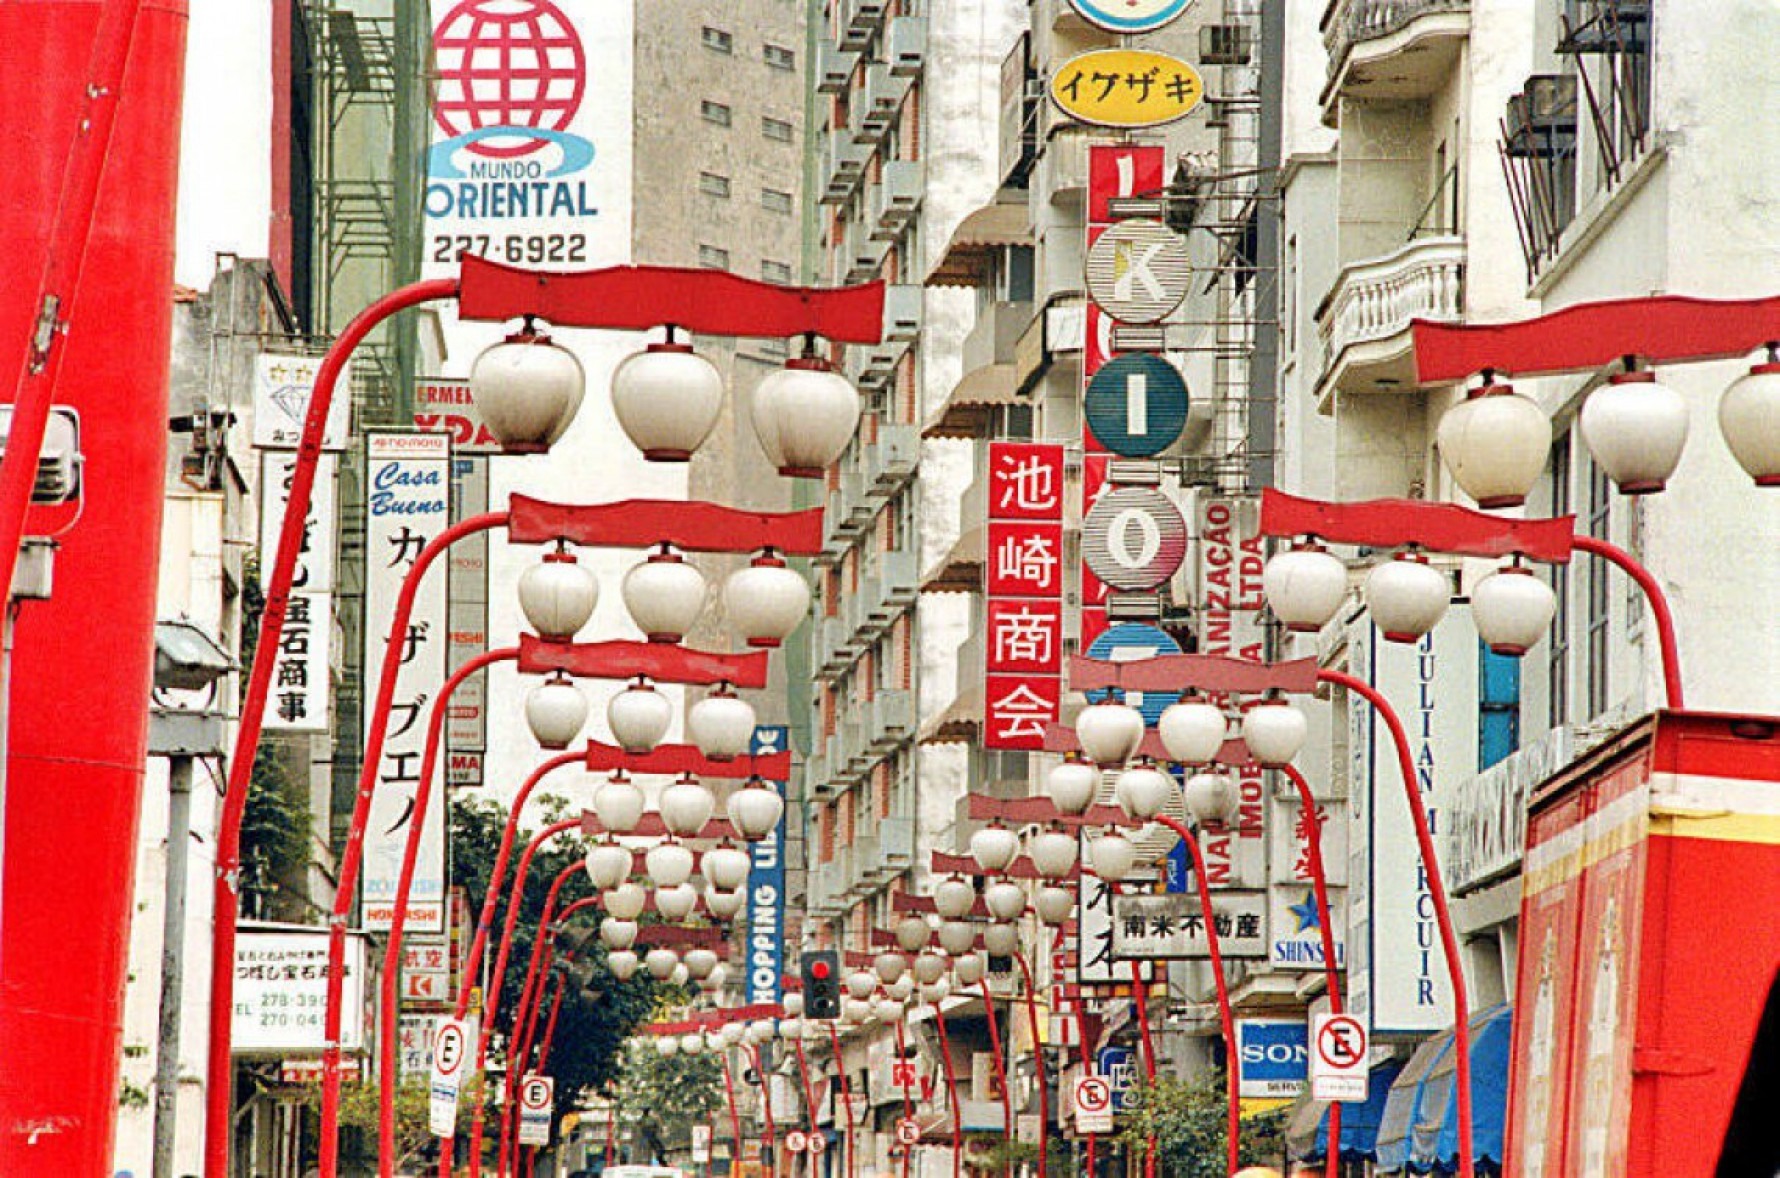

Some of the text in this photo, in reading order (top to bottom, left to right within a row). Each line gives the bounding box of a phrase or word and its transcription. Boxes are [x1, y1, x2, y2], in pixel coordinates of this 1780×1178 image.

[470, 161, 541, 178] MUNDO
[425, 181, 598, 218] ORIENTAL
[375, 462, 440, 490] Casa
[370, 492, 445, 516] Bueno
[1239, 535, 1264, 610] LTDA
[992, 455, 1057, 738] 池崎商会
[1418, 631, 1436, 793] JULIAN
[752, 885, 777, 1004] HOPPING
[1275, 941, 1344, 964] SHINSI
[443, 1036, 455, 1062] E
[1243, 1044, 1307, 1062] SON
[1334, 1029, 1350, 1056] E
[530, 1086, 541, 1101] E
